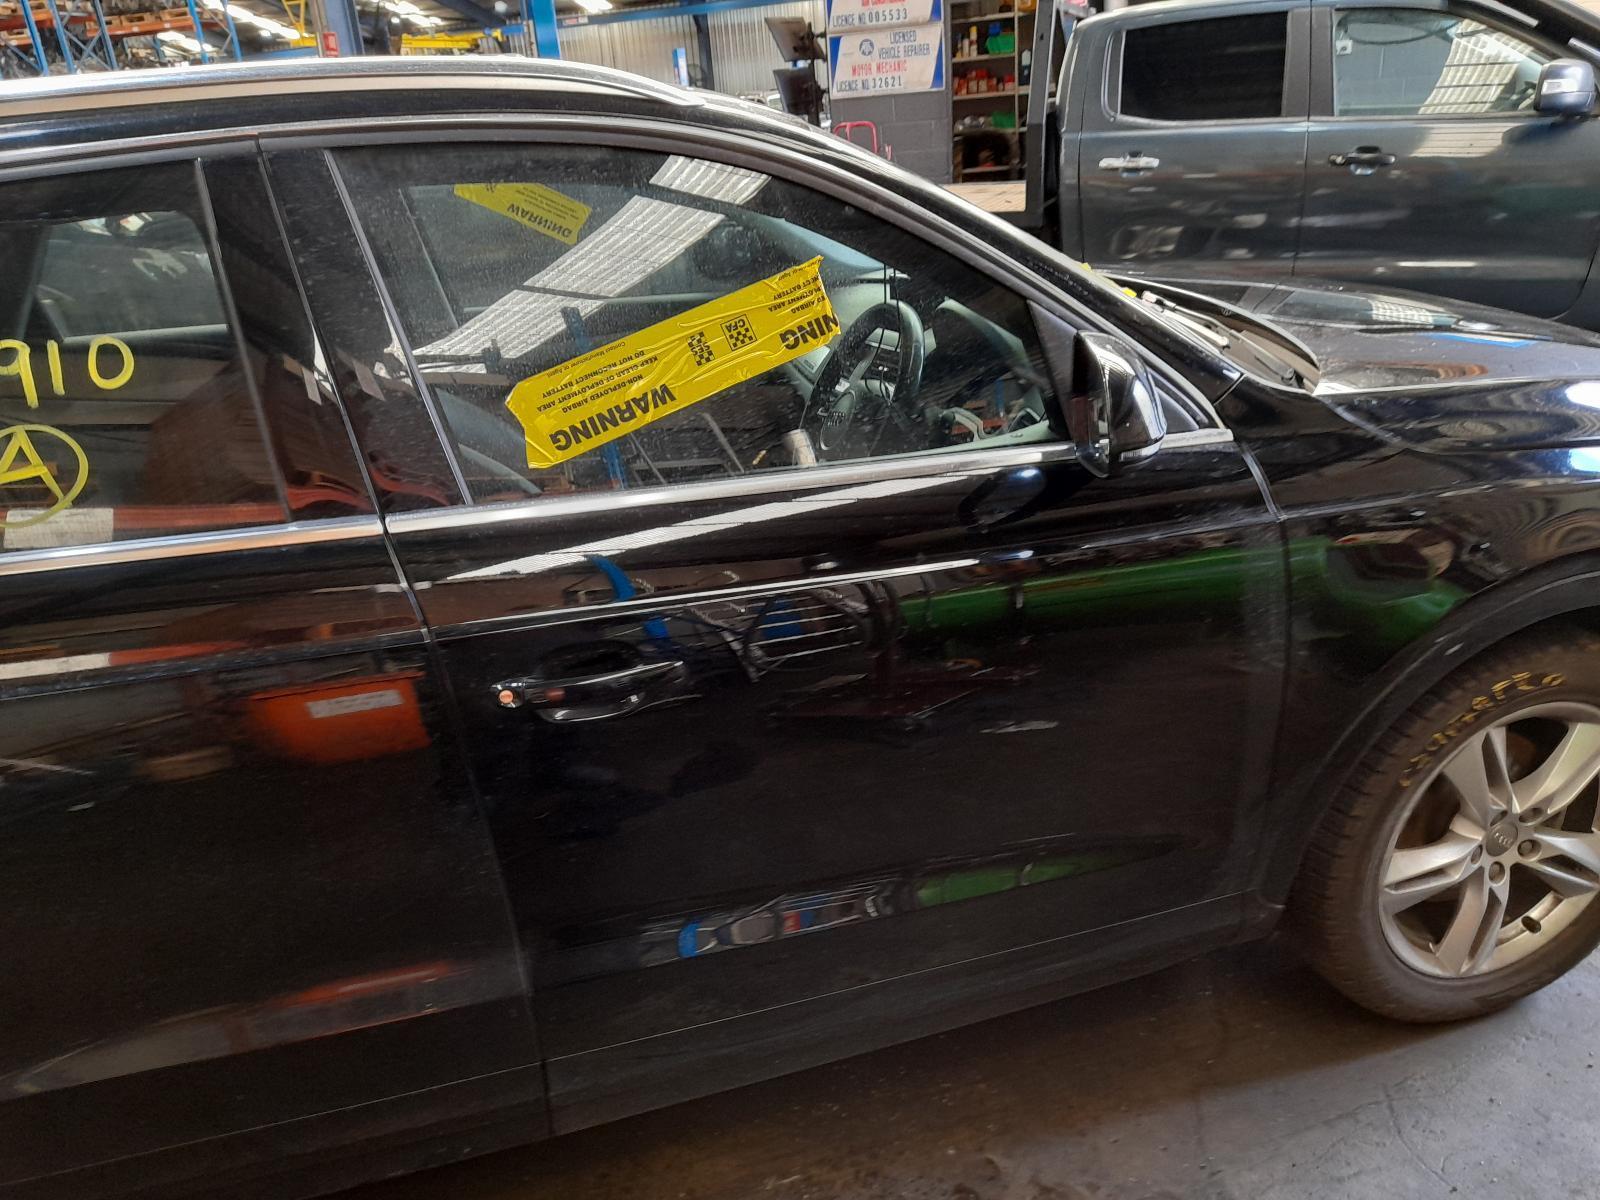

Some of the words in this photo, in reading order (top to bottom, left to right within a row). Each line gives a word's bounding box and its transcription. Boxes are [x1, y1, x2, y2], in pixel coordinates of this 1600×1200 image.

[832, 14, 854, 27] LICENCE
[868, 8, 908, 23] 005533
[889, 30, 917, 44] LICENSED
[878, 46, 900, 59] VEHICLE
[903, 43, 930, 58] REPAIRER
[851, 63, 872, 77] MOTOR
[876, 60, 908, 74] MECHANIC
[836, 79, 858, 92] LICENCE
[872, 76, 902, 89] 32621
[774, 285, 801, 300] BATTERY
[768, 302, 785, 312] AREA
[725, 319, 746, 333] CFA
[779, 313, 838, 350] NING
[691, 342, 710, 356] SES
[619, 356, 633, 365] NOT
[640, 356, 658, 367] KEEP
[576, 362, 617, 384] RECONNECT
[605, 374, 614, 383] OF
[616, 365, 638, 377] CLEAR
[543, 381, 573, 398] BATTERY
[558, 380, 604, 403] DEPLOYMENT
[590, 374, 643, 400] NON-DEPLOYED
[537, 401, 555, 411] AREA
[562, 398, 588, 413] AIRBAG
[549, 384, 676, 450] WARNING
